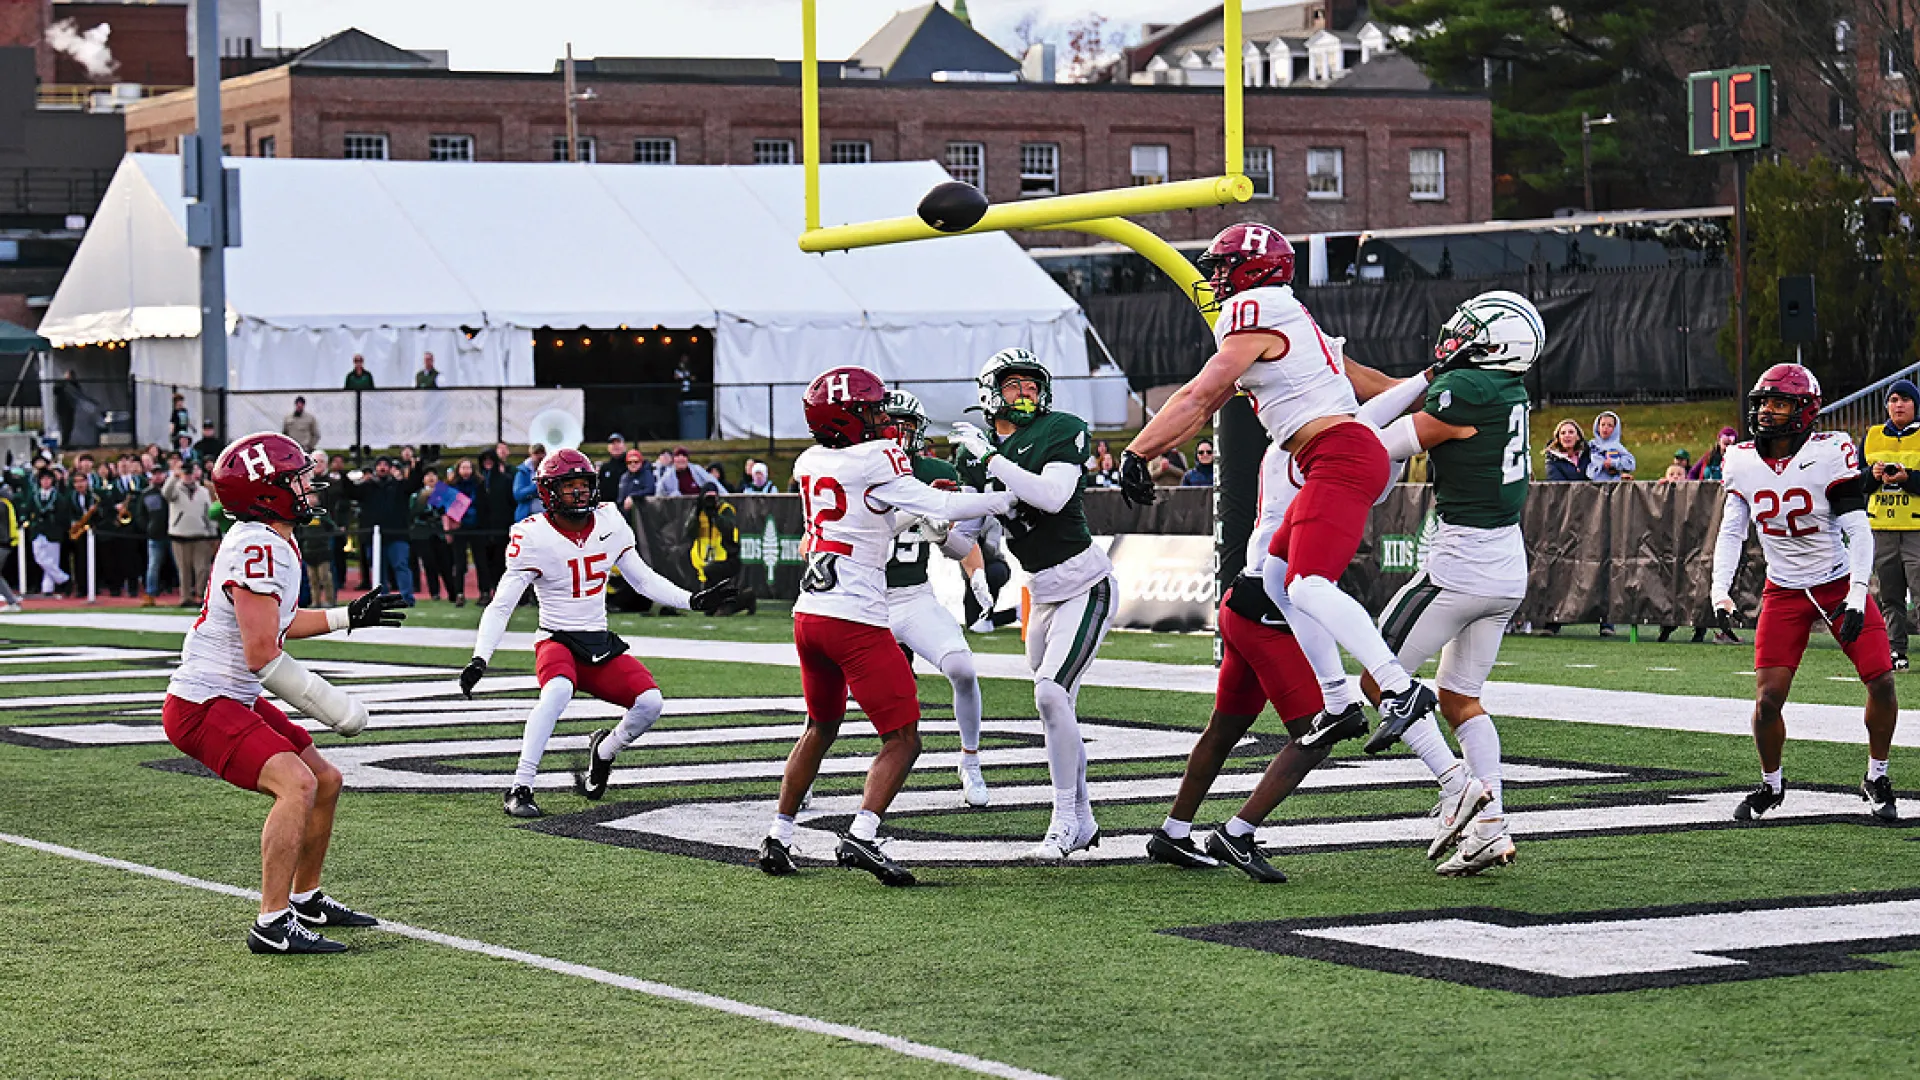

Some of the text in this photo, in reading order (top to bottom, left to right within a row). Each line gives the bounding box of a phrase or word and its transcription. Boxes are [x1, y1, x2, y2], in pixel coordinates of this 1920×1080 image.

[1711, 72, 1756, 141] 16
[1241, 226, 1271, 255] H
[1230, 299, 1260, 333] 10
[825, 373, 851, 405] H
[1502, 401, 1532, 485] 2
[239, 442, 275, 482] H
[883, 448, 913, 476] 12
[801, 474, 854, 557] 12
[1753, 487, 1820, 537] 22
[1875, 494, 1909, 506] PHOTO
[242, 544, 274, 579] 21
[1383, 540, 1414, 567] KIDS
[567, 553, 608, 598] 15
